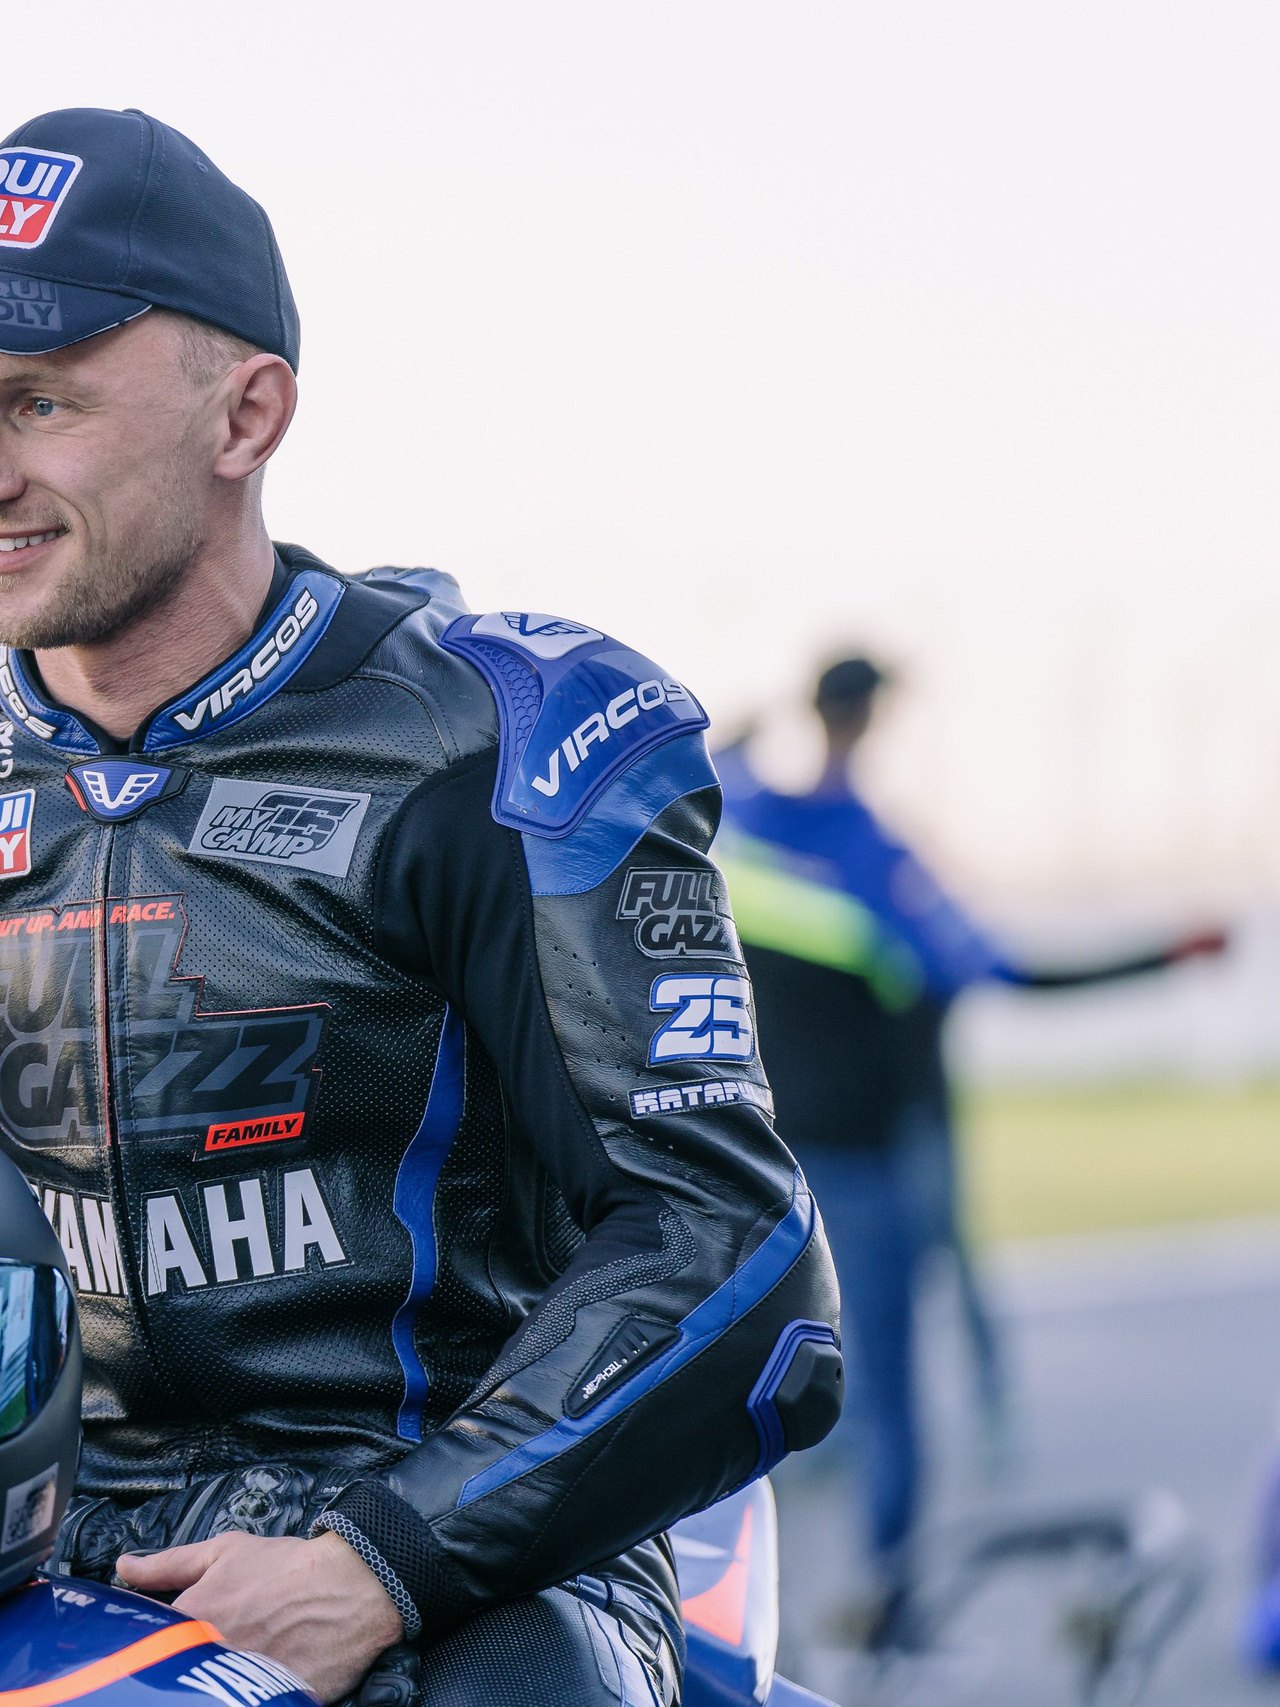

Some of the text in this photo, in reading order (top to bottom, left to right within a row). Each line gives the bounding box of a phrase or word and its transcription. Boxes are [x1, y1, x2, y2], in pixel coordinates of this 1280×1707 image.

[174, 589, 318, 732] VIRCOS
[531, 679, 688, 797] VIRCOS
[201, 826, 315, 859] CAMP
[624, 873, 716, 912] FULL
[58, 909, 102, 931] AND
[109, 902, 176, 924] RACE.
[211, 1118, 300, 1145] FAMILY
